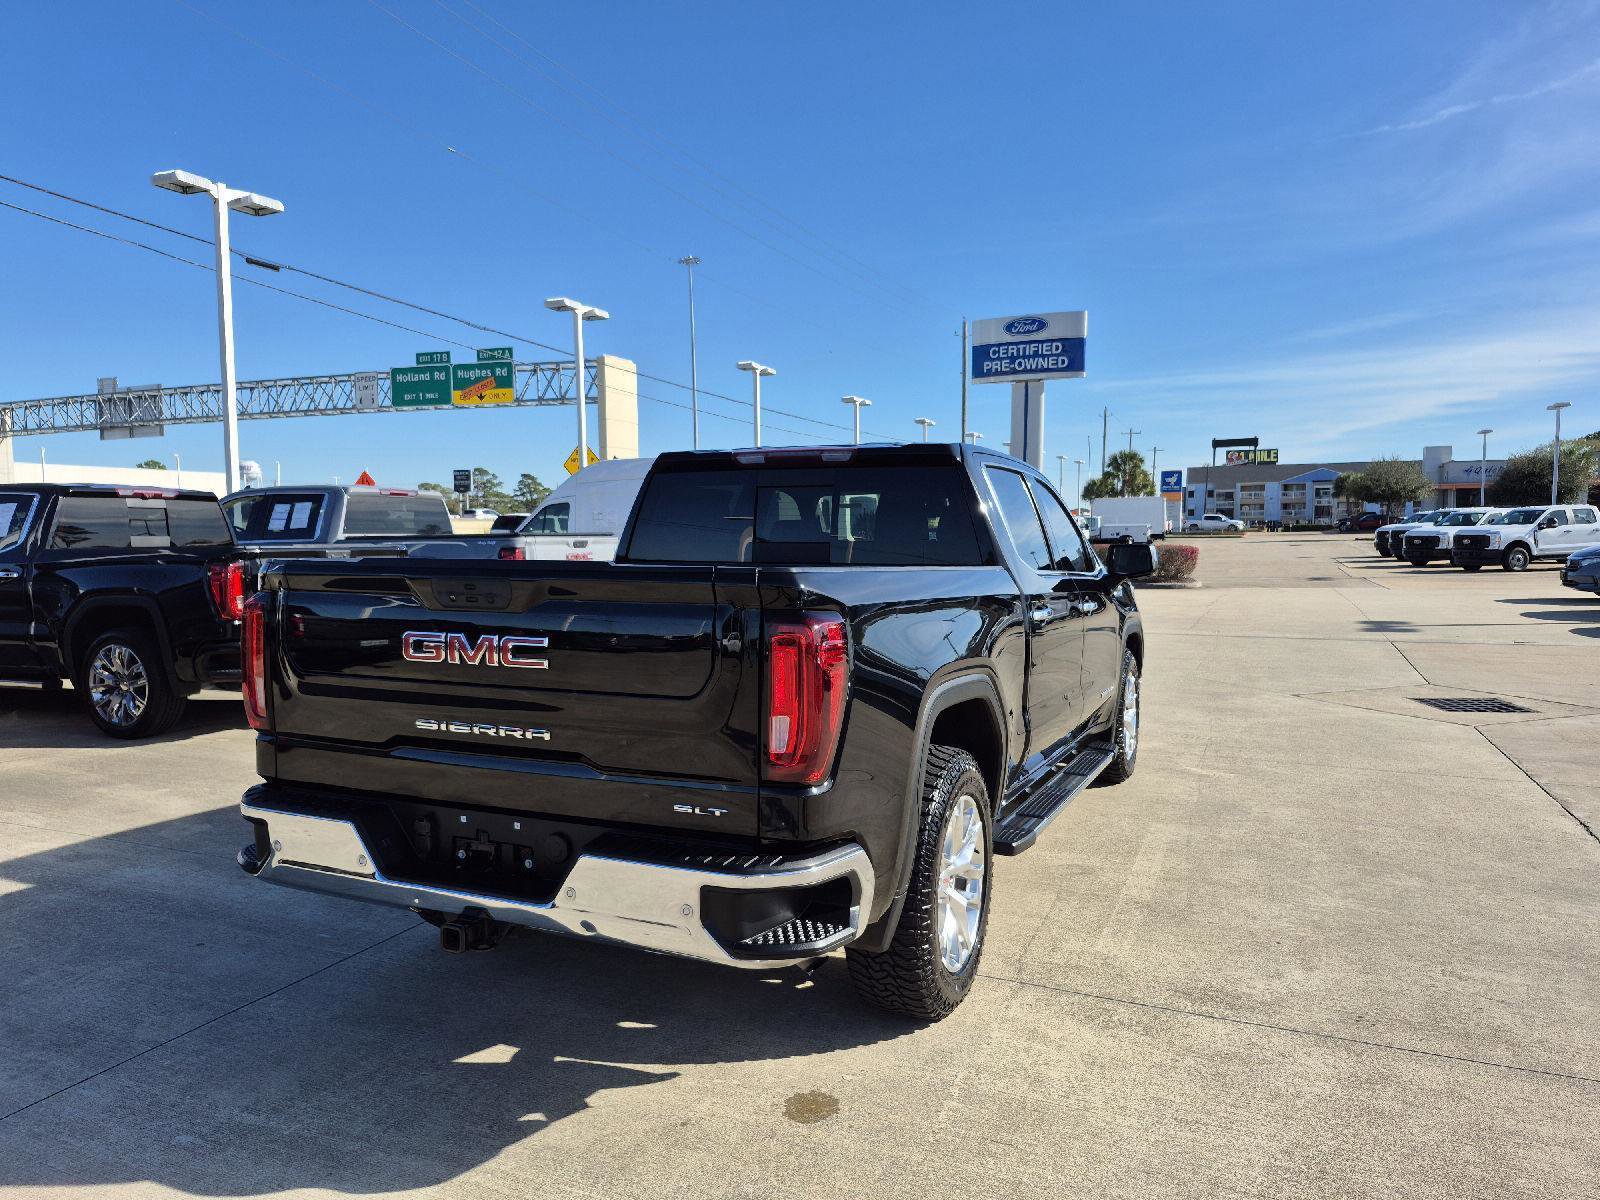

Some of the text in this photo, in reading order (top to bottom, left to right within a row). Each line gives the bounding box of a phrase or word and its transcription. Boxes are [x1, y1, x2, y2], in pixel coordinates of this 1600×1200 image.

[1012, 320, 1039, 333] Ford
[989, 342, 1063, 358] CERTIFIED
[983, 356, 1068, 373] PRE-OWNED
[396, 371, 446, 383] Holland Rd
[457, 367, 508, 380] Hughes Rd
[474, 379, 495, 393] CLOSED
[488, 392, 507, 400] ONLY
[402, 630, 549, 669] GMC
[415, 718, 551, 741] SIERRA
[673, 804, 729, 817] SLT
